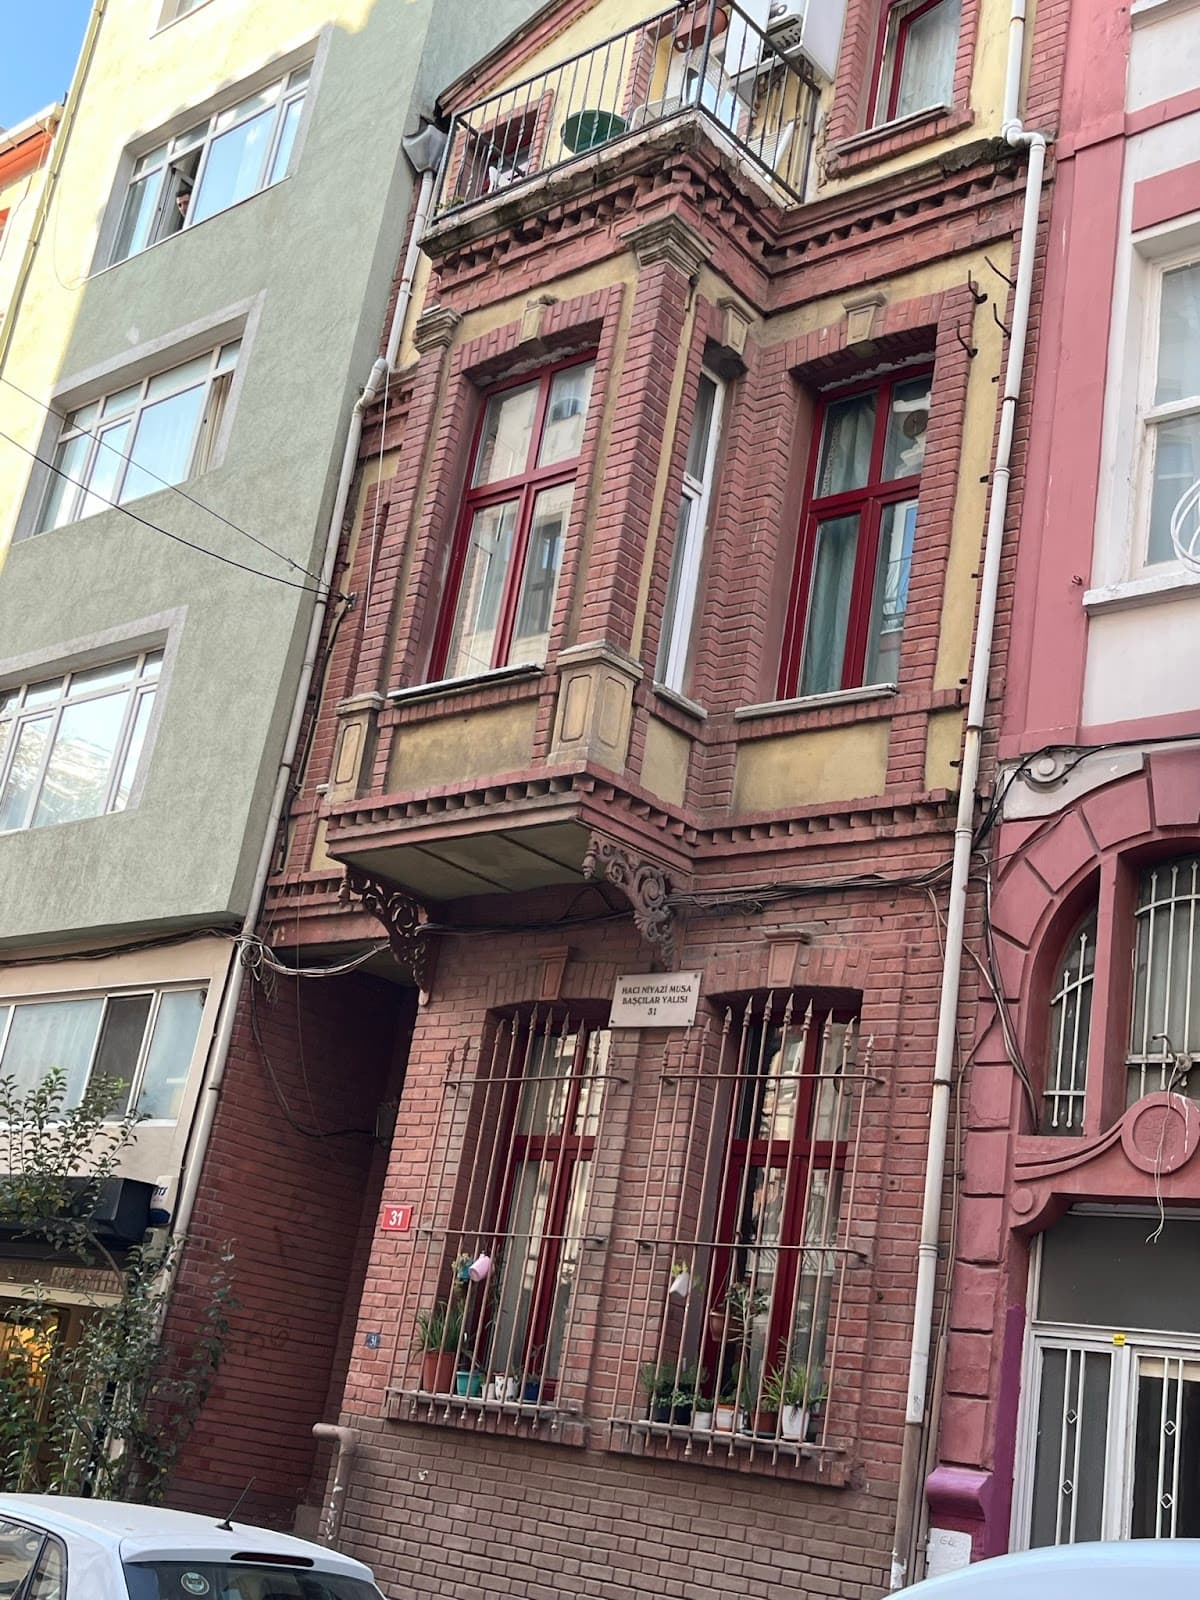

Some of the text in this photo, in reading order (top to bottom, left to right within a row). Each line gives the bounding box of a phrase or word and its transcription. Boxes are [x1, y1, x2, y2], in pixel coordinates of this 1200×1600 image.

[669, 984, 692, 993] MUSA
[647, 1007, 657, 1016] 31
[389, 1209, 404, 1226] 31
